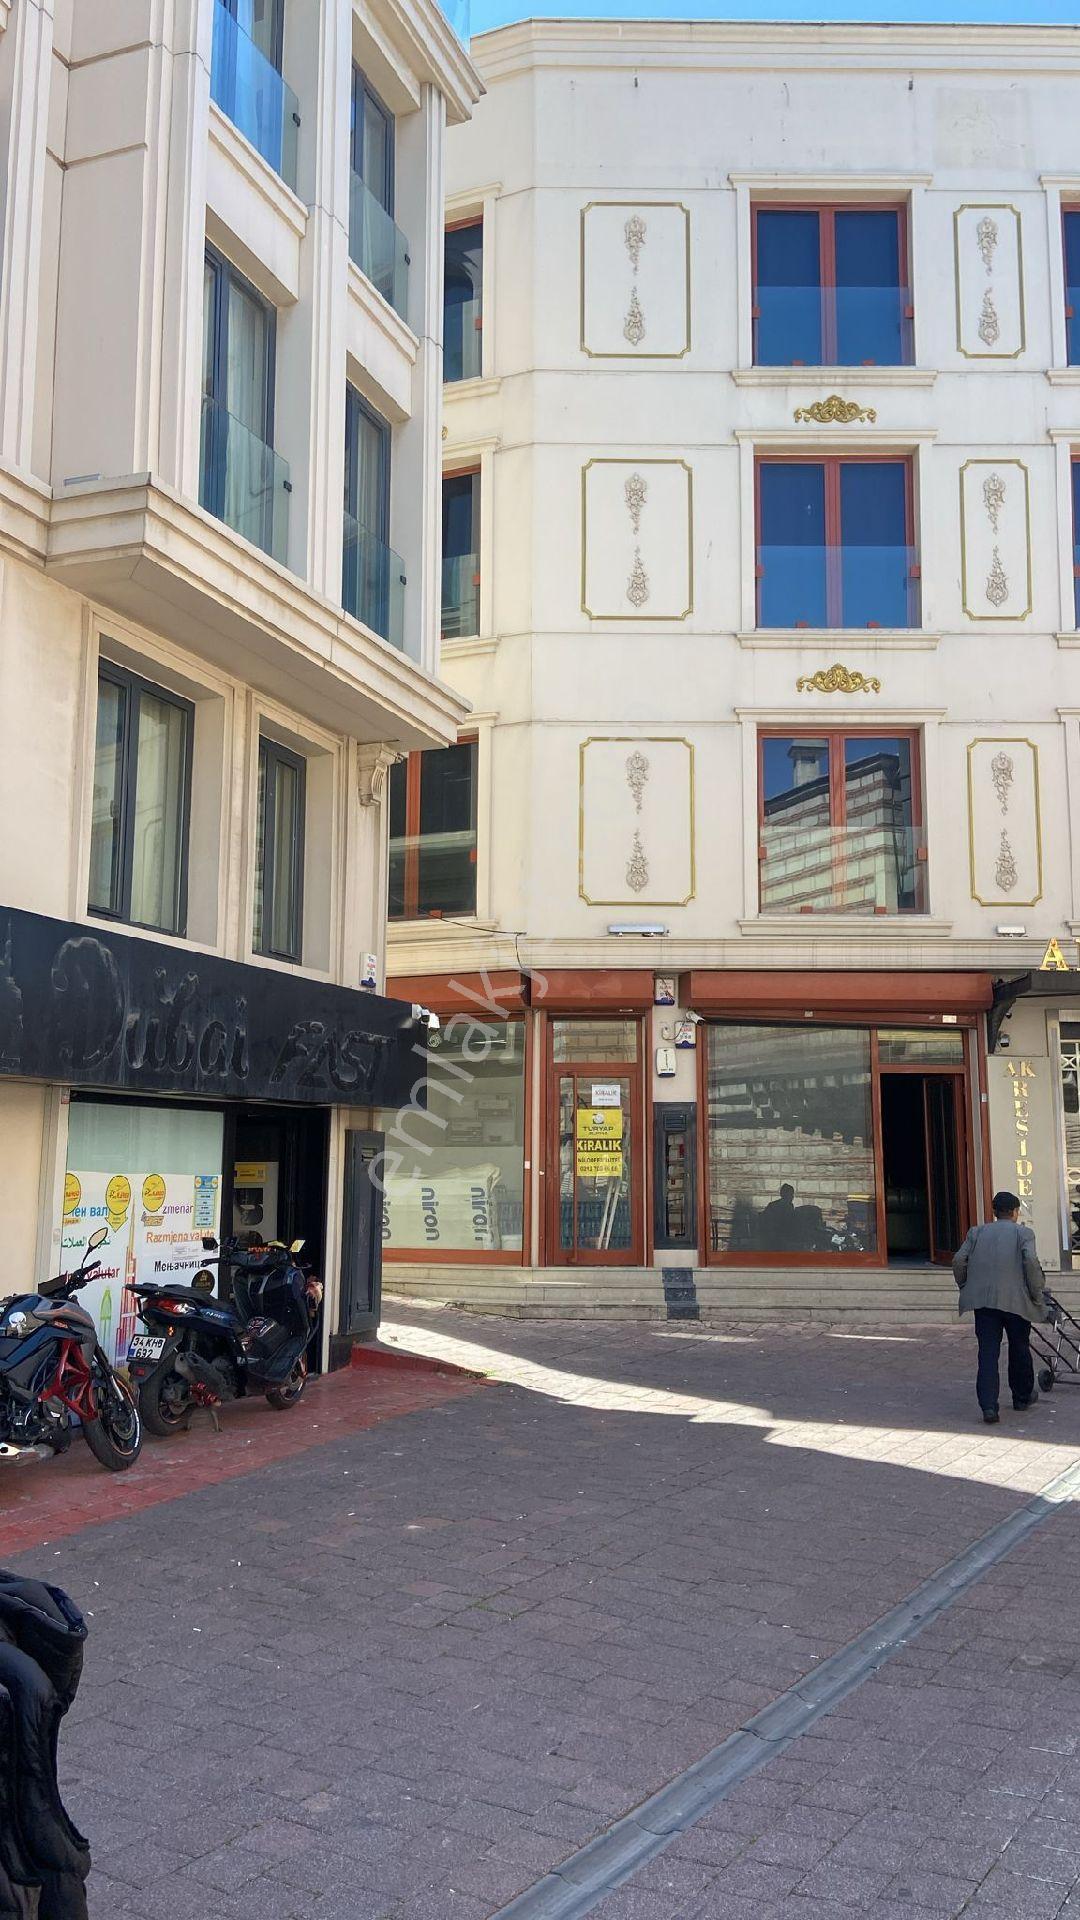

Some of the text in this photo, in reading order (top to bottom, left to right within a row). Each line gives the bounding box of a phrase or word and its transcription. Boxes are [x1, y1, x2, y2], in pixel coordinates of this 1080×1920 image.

[1013, 1080, 1034, 1225] RESIDEN
[421, 1187, 440, 1241] niron
[133, 1337, 144, 1347] 34
